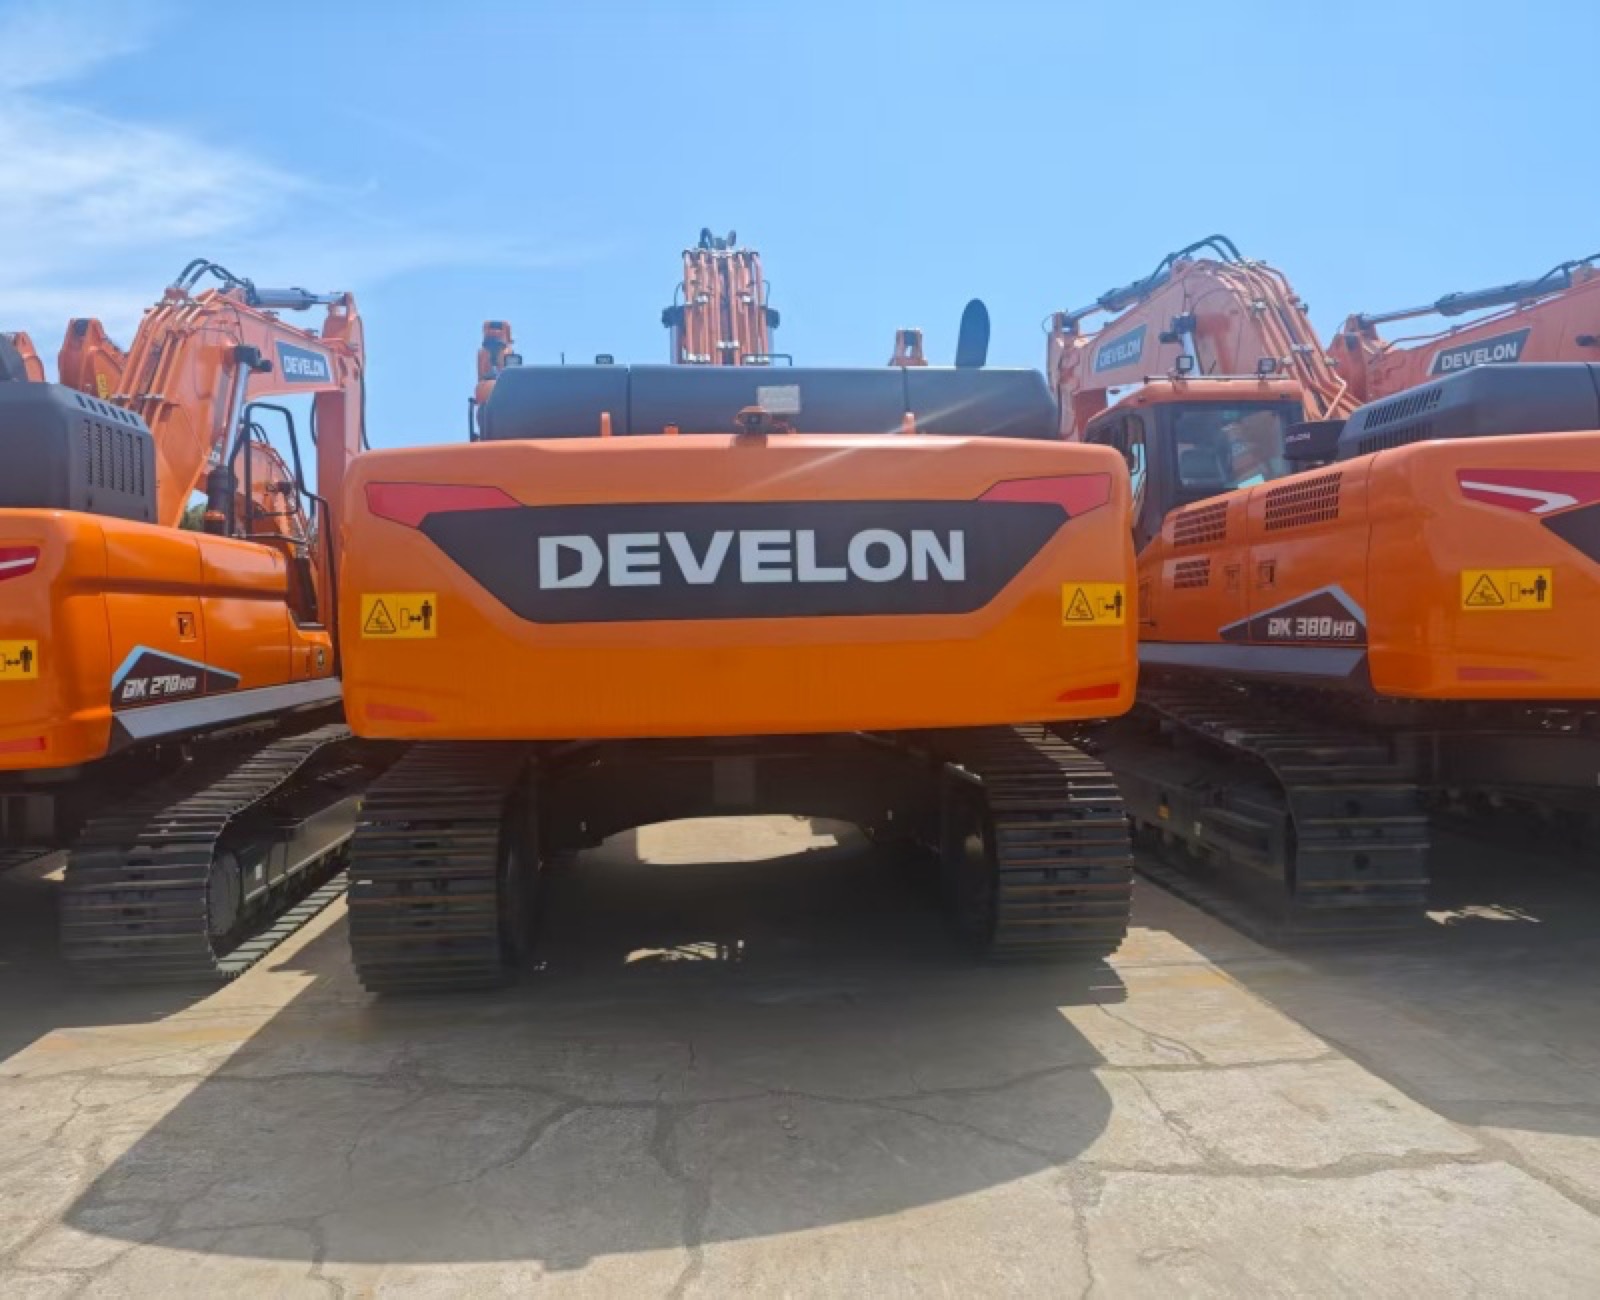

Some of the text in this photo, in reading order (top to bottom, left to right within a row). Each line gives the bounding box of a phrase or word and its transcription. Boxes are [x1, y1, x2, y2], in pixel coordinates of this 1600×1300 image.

[283, 355, 325, 377] DEVELON
[1441, 341, 1517, 371] DEVELON
[538, 528, 966, 589] DEVELON
